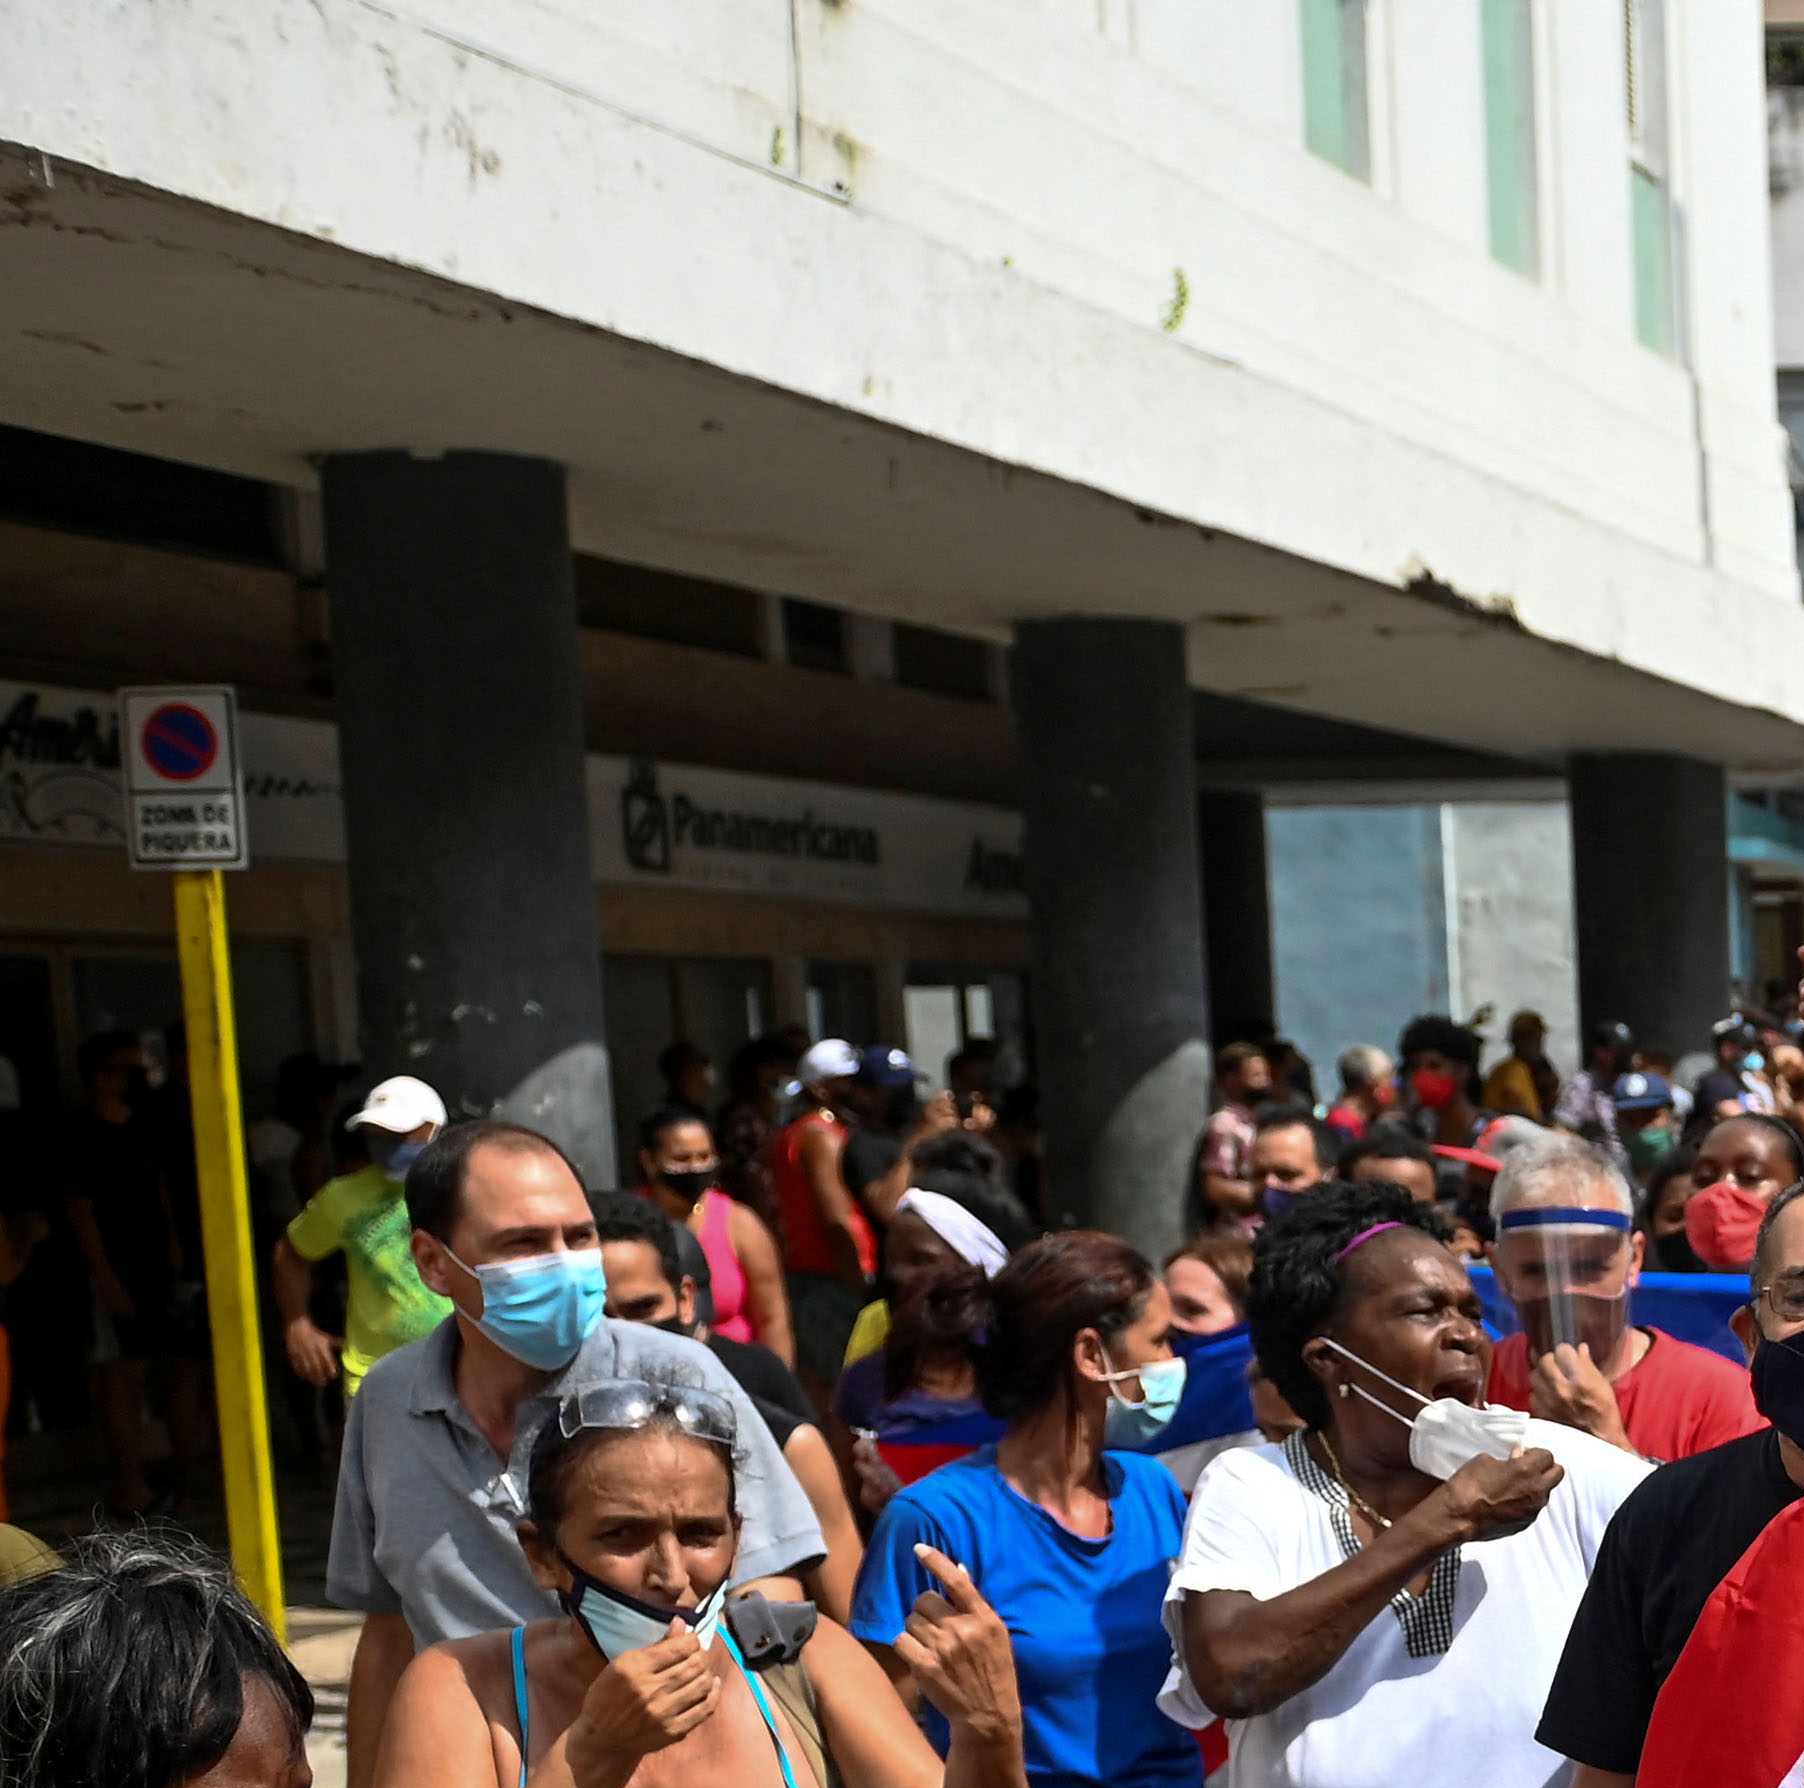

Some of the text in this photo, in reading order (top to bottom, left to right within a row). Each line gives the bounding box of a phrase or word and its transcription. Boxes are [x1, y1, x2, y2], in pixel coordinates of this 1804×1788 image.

[141, 803, 229, 824] ZONA DE
[672, 793, 880, 866] Panamericana
[142, 832, 232, 853] PIQUERA
